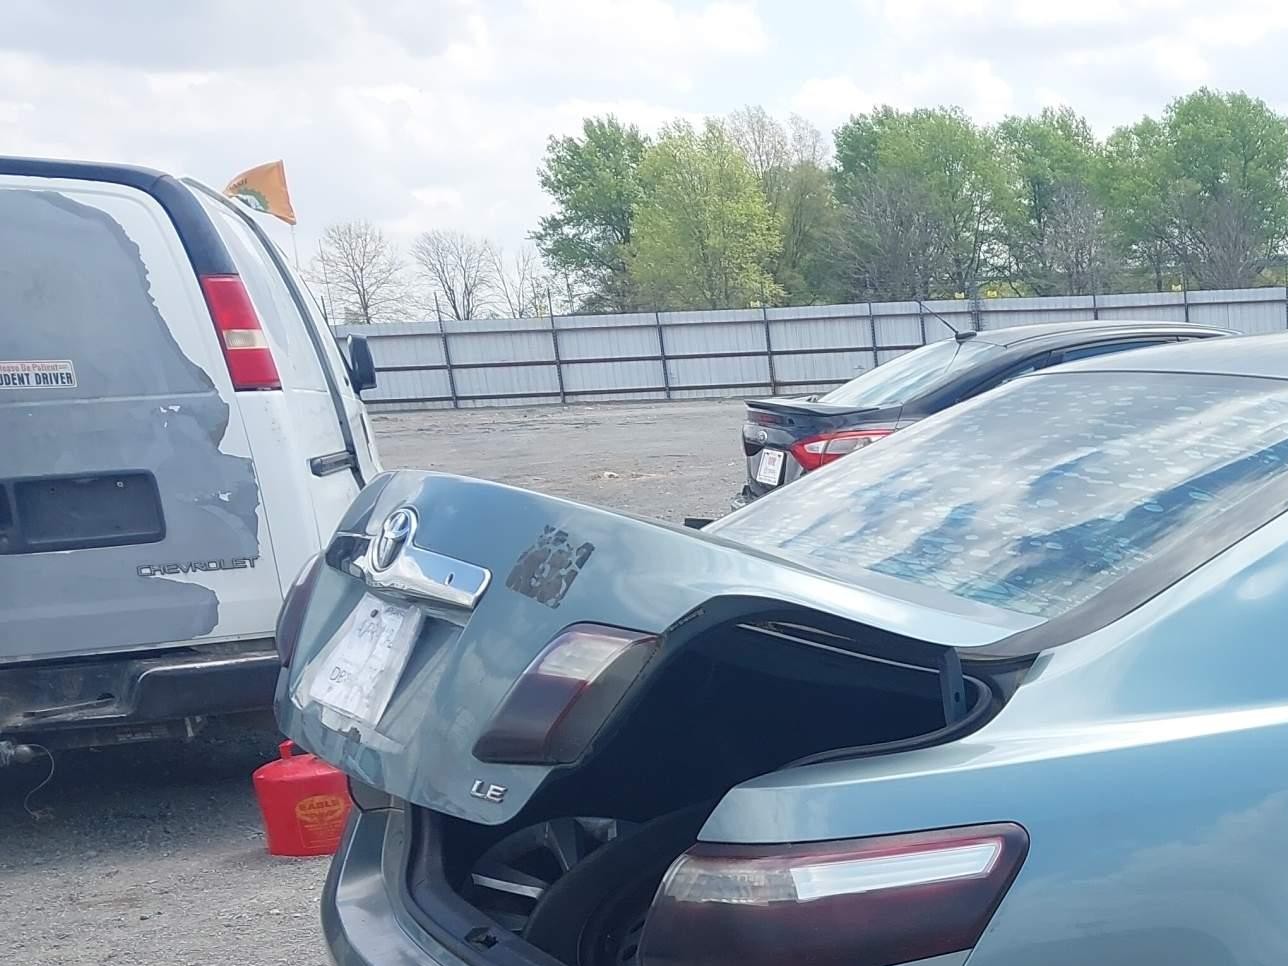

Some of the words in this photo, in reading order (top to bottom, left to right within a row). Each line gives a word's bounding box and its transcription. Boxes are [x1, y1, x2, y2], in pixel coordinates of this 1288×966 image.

[35, 372, 73, 384] DRIVER
[136, 557, 257, 576] CHEVROLET
[470, 779, 508, 803] LE
